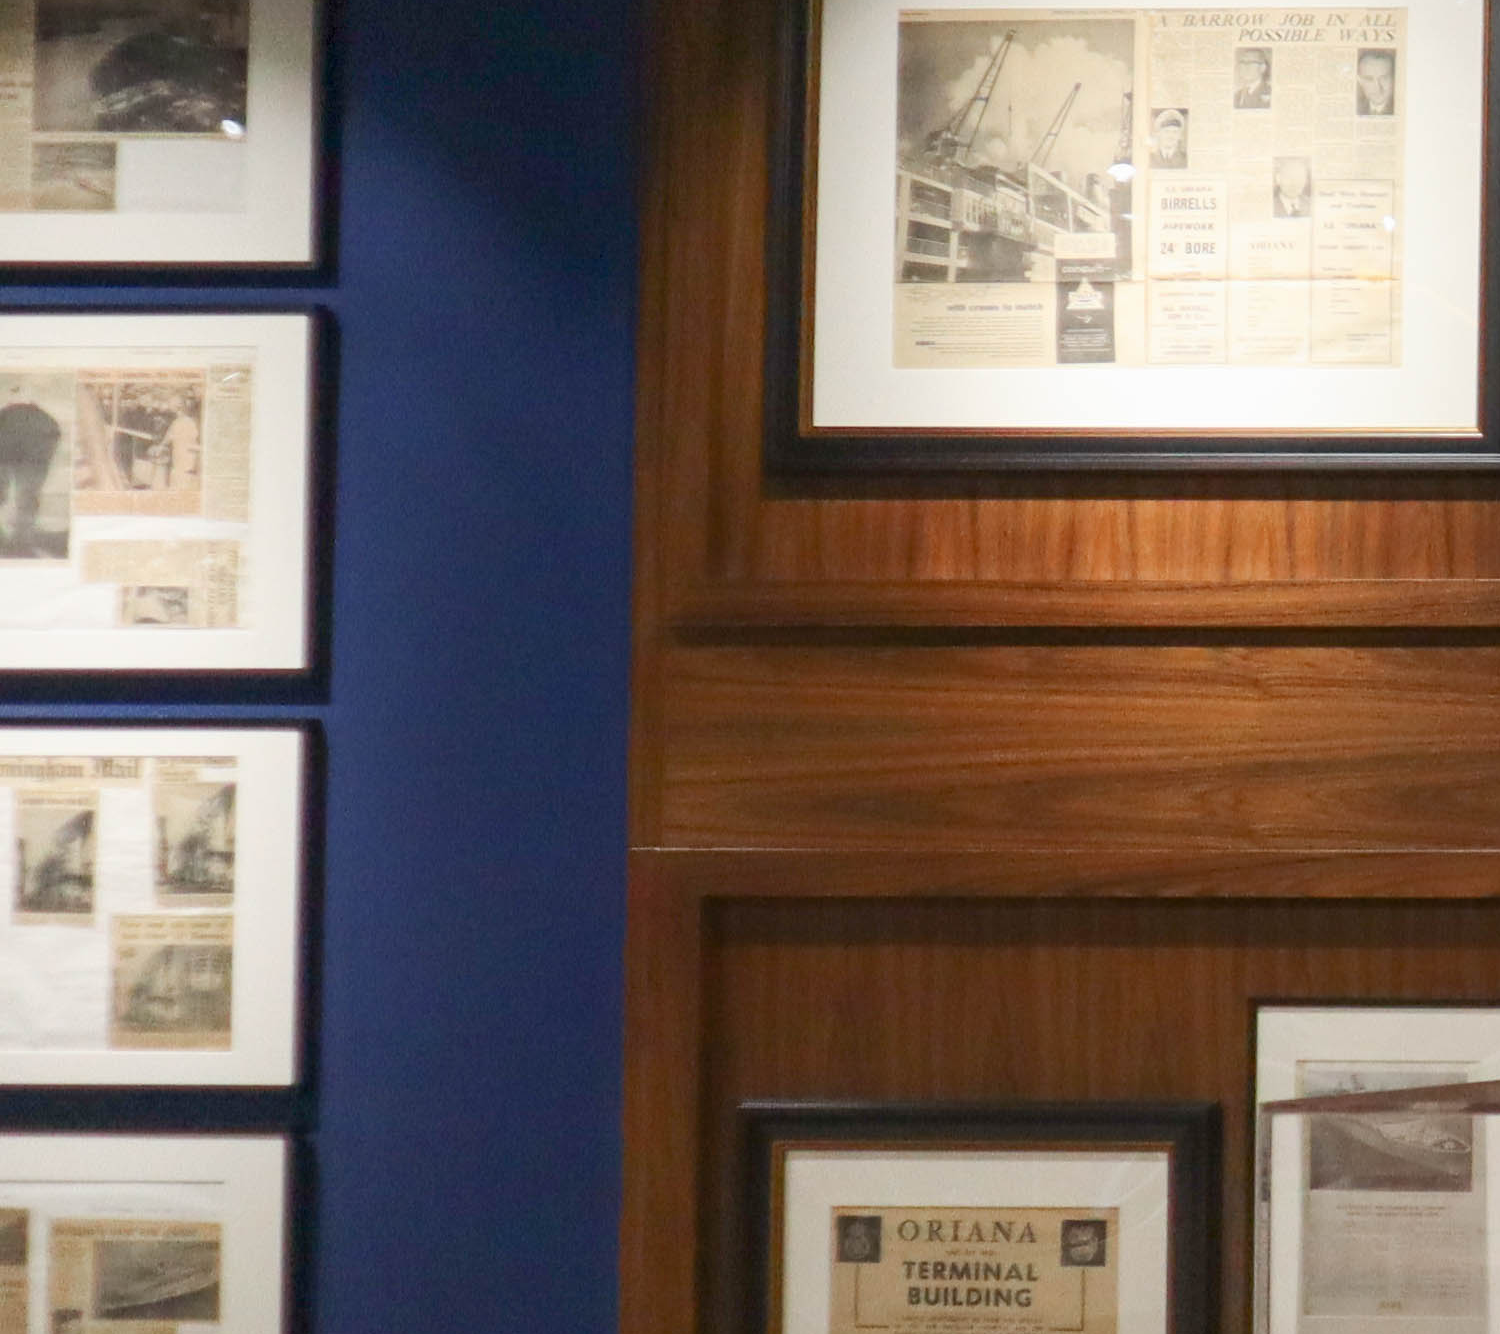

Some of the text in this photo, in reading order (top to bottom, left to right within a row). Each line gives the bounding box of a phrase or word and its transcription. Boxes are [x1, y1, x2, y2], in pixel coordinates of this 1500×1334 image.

[1183, 14, 1266, 27] BARROW
[1281, 14, 1315, 27] JOB
[1326, 14, 1346, 27] IN
[1359, 14, 1397, 27] ALL
[1238, 29, 1396, 42] POSSIBLE WAYS
[1161, 198, 1217, 211] BIRRELLS
[1185, 243, 1216, 254] BORE
[897, 1220, 1037, 1244] ORIANA
[903, 1261, 1040, 1282] TERMINAL
[907, 1288, 1032, 1307] BUILDING
